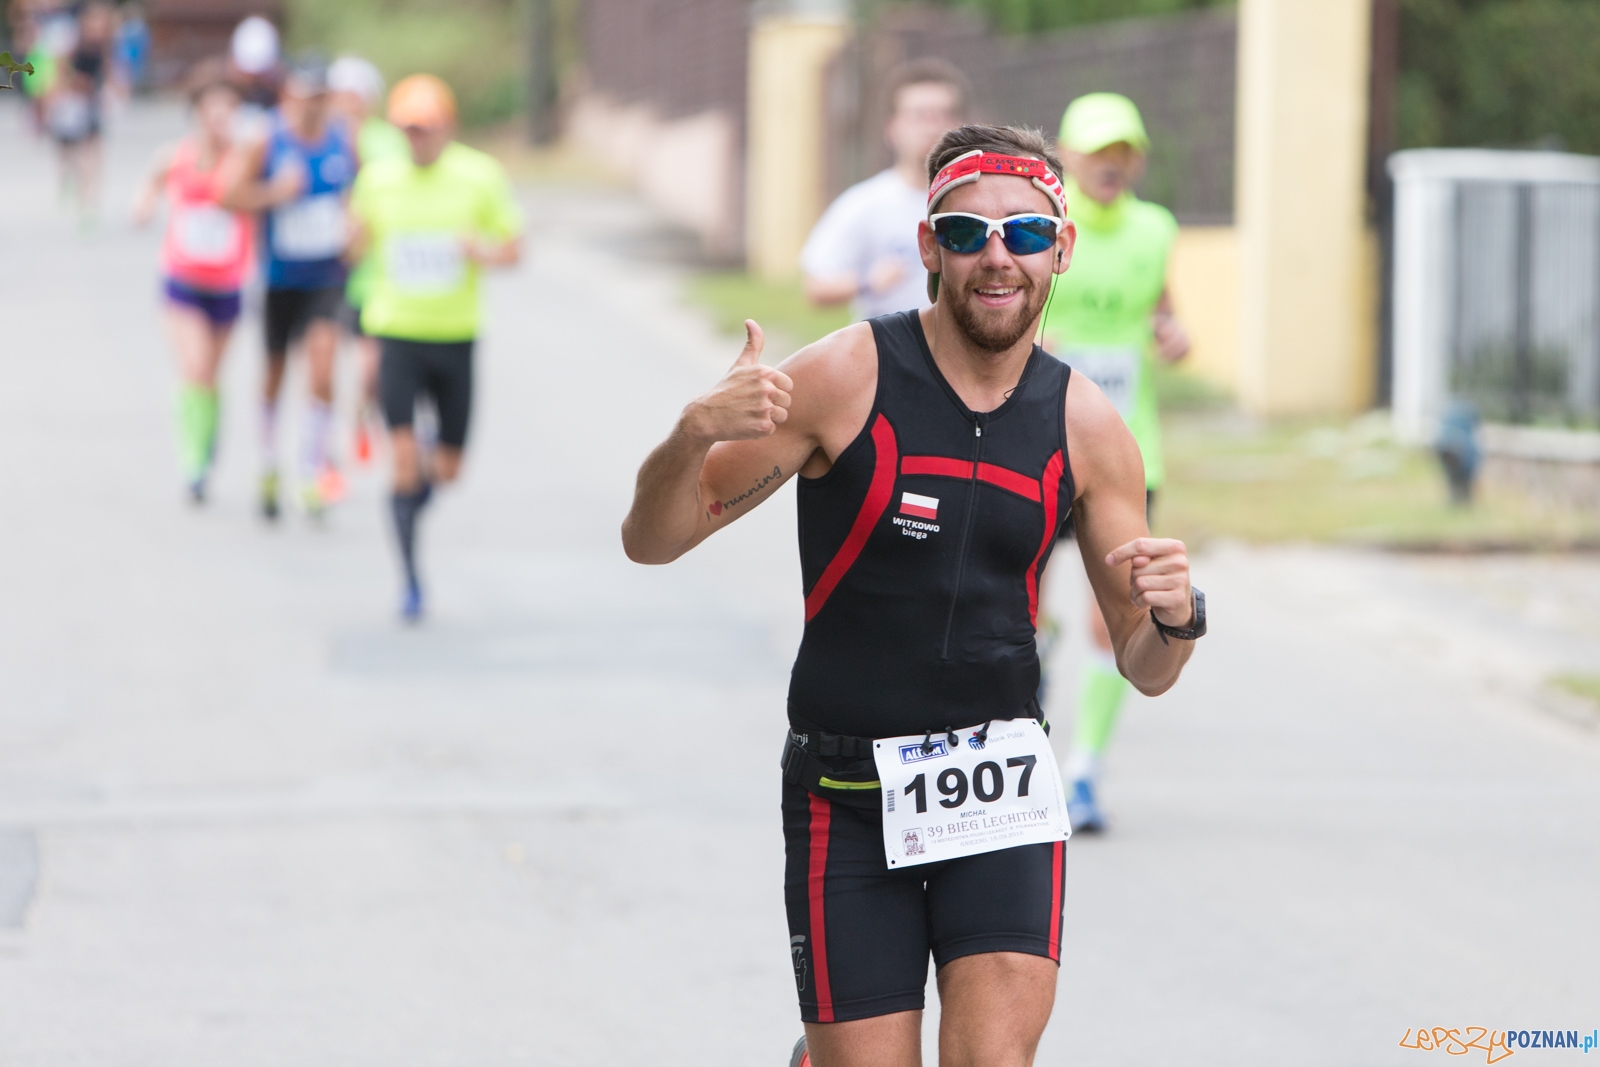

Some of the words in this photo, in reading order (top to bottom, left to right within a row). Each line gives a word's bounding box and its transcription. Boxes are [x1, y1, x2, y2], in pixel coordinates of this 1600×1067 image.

[723, 465, 782, 510] running
[892, 517, 940, 533] WITKOWO
[902, 527, 927, 540] biega
[988, 735, 1005, 743] Bank
[1006, 731, 1026, 739] Polski
[904, 754, 1037, 814] 1907
[960, 809, 988, 819] MICHAŁ
[927, 825, 943, 838] 39
[947, 819, 979, 835] BIEG
[982, 807, 1049, 829] LECHITÓW
